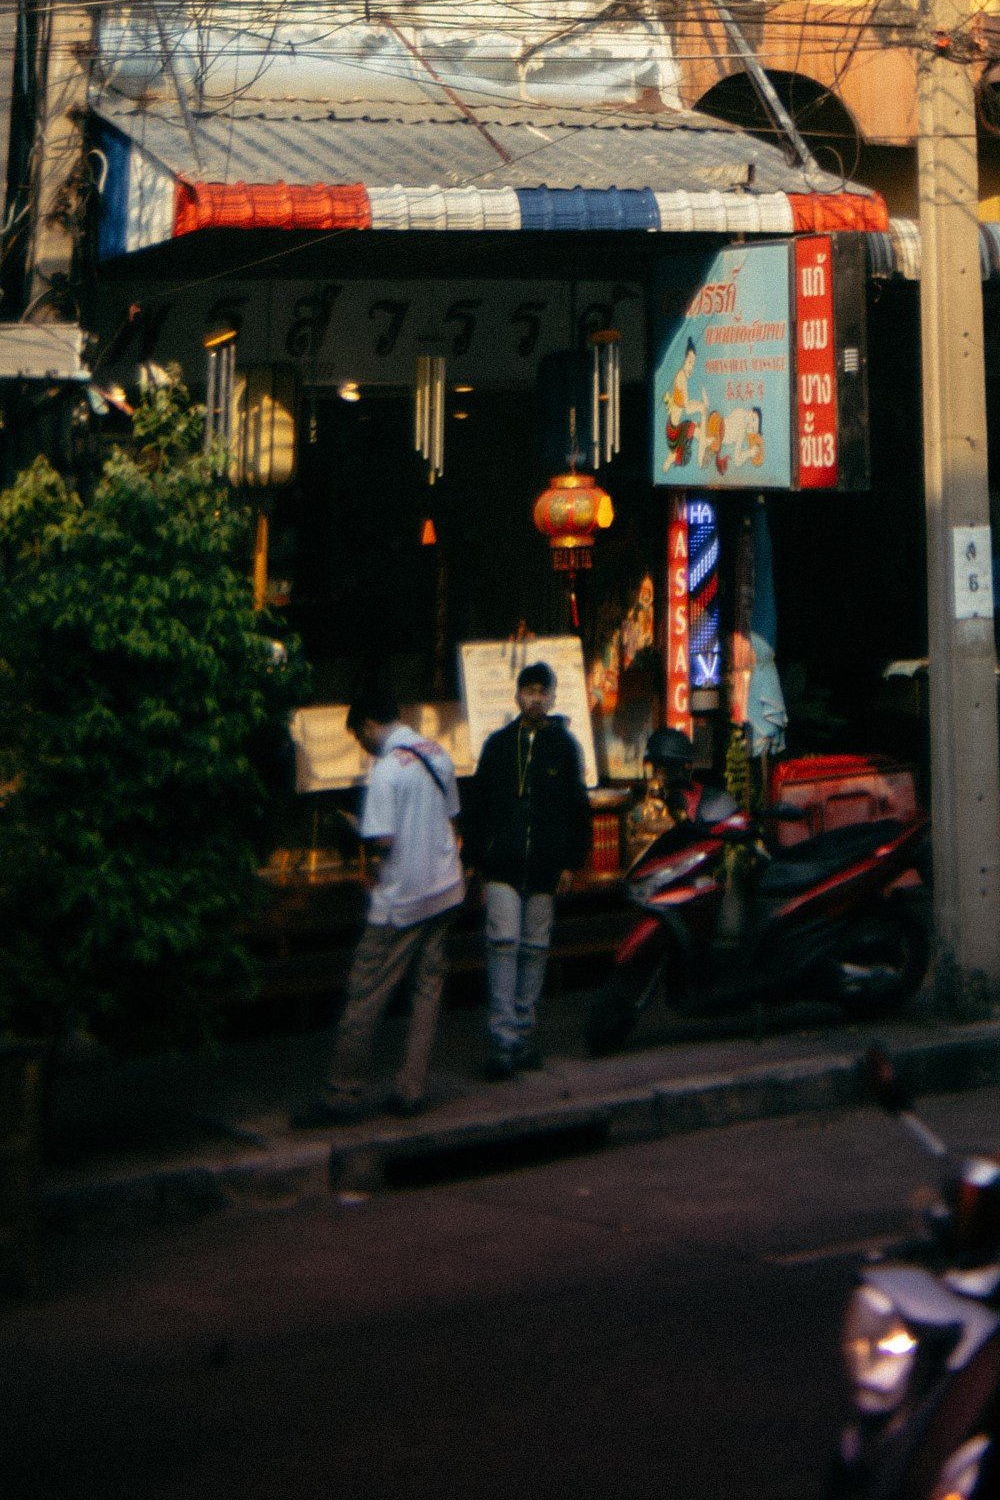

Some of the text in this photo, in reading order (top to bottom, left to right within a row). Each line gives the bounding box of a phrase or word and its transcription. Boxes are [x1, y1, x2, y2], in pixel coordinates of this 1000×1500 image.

[802, 254, 825, 298] แก้
[802, 321, 827, 351] ผม
[802, 375, 832, 405] บาง
